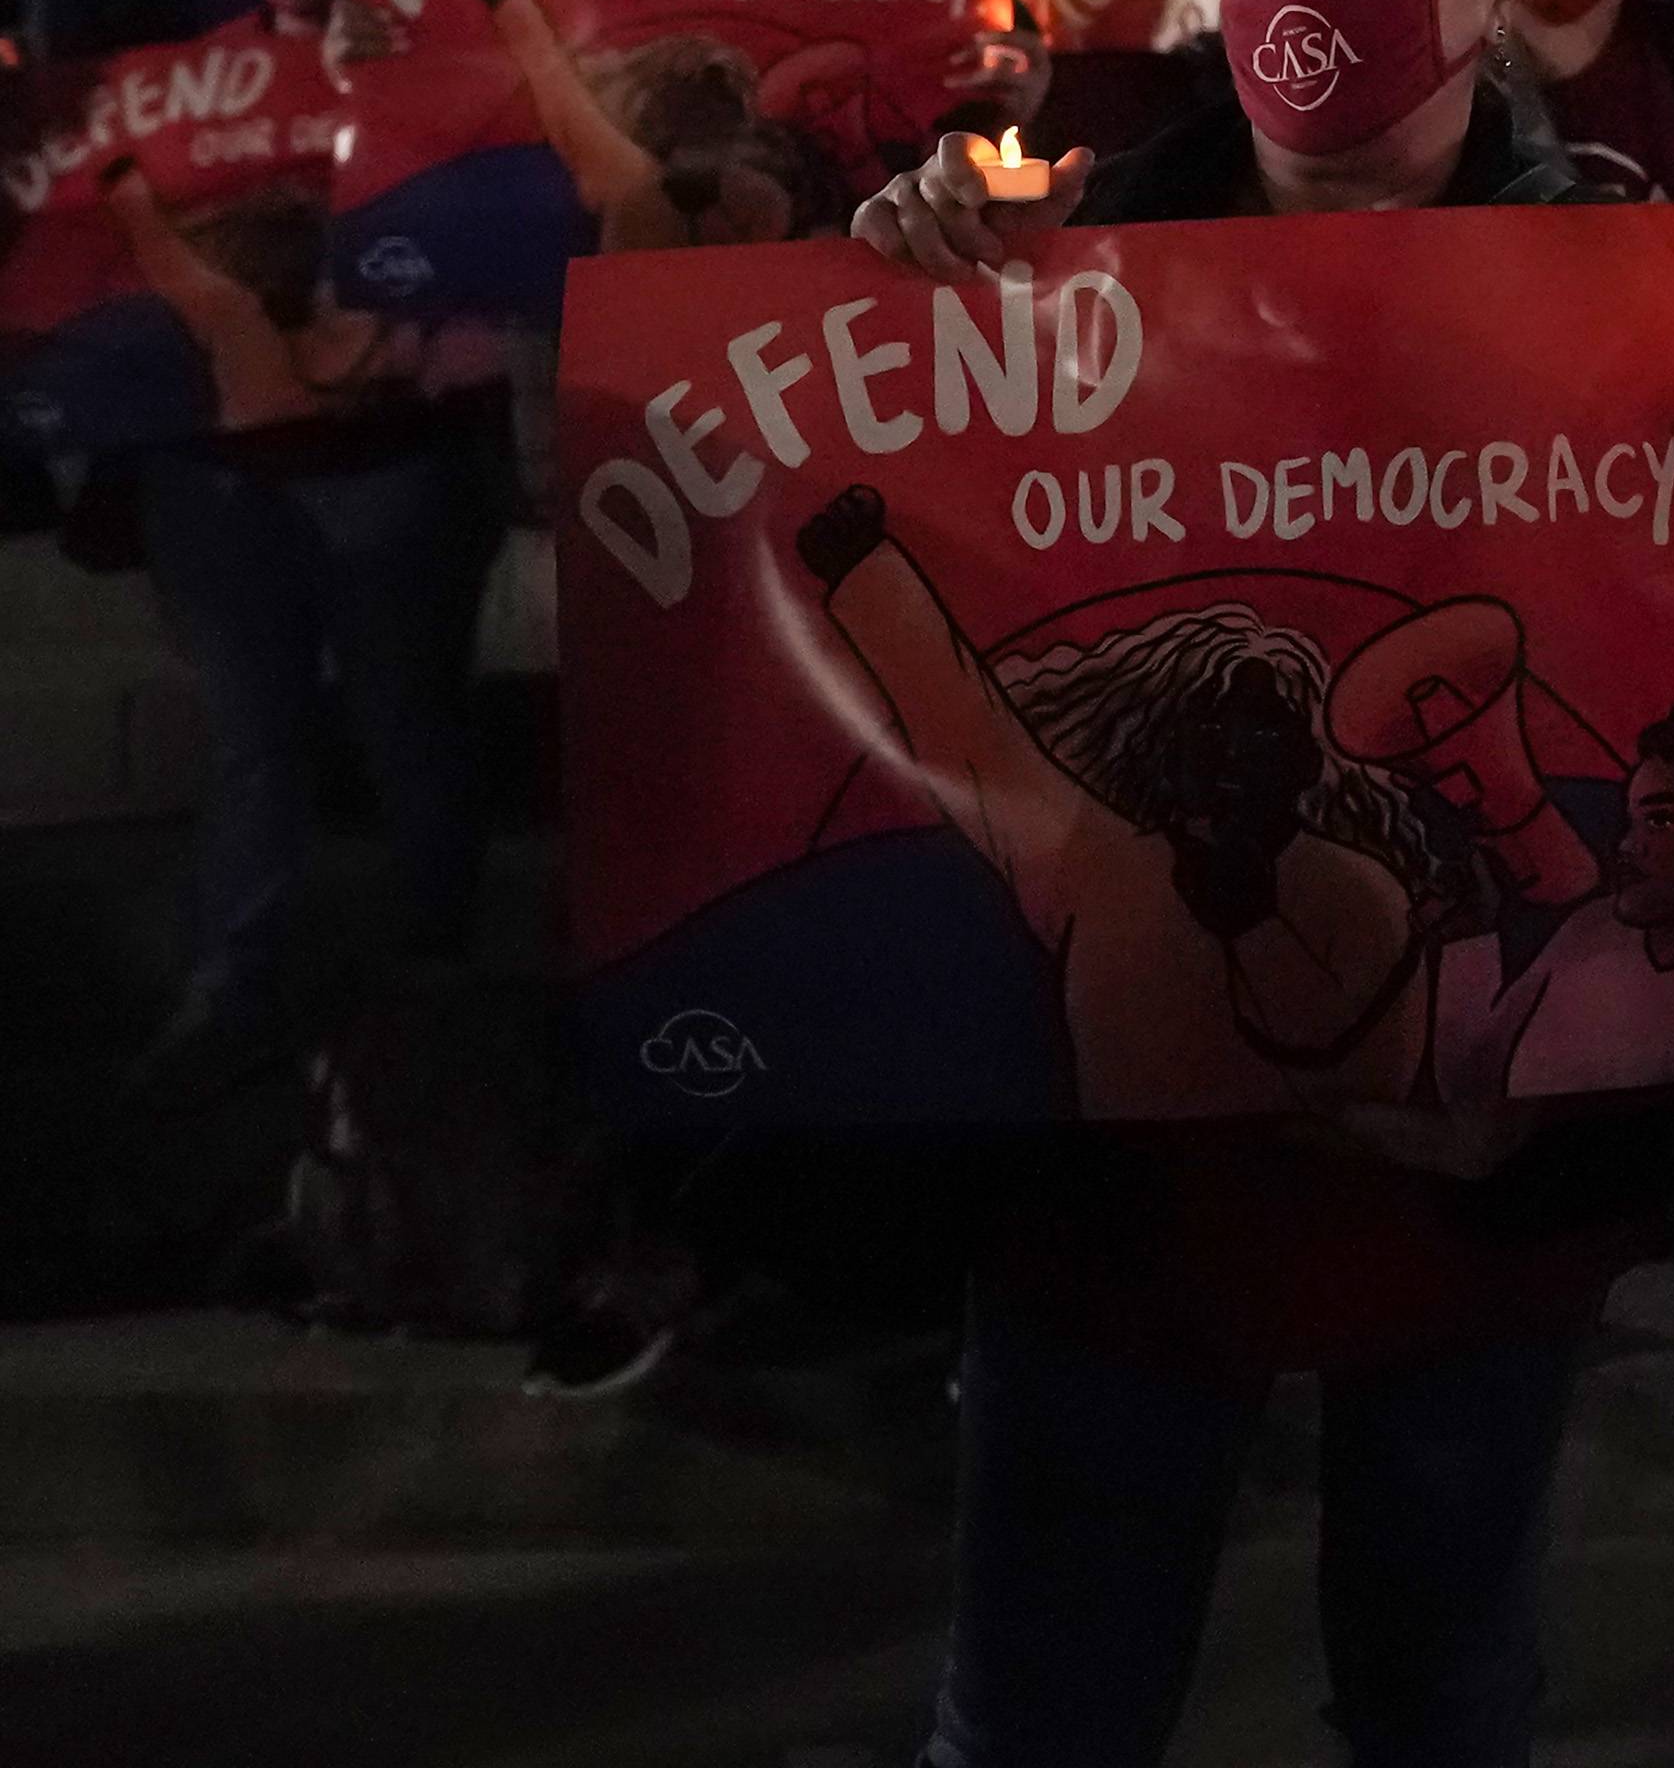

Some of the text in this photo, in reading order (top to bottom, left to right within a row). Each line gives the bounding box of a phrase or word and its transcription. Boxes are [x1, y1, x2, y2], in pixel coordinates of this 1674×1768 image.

[1252, 27, 1364, 84] CASA
[577, 258, 1145, 611] DEFEND
[1011, 455, 1188, 551] OUR
[638, 1033, 769, 1074] CASA
